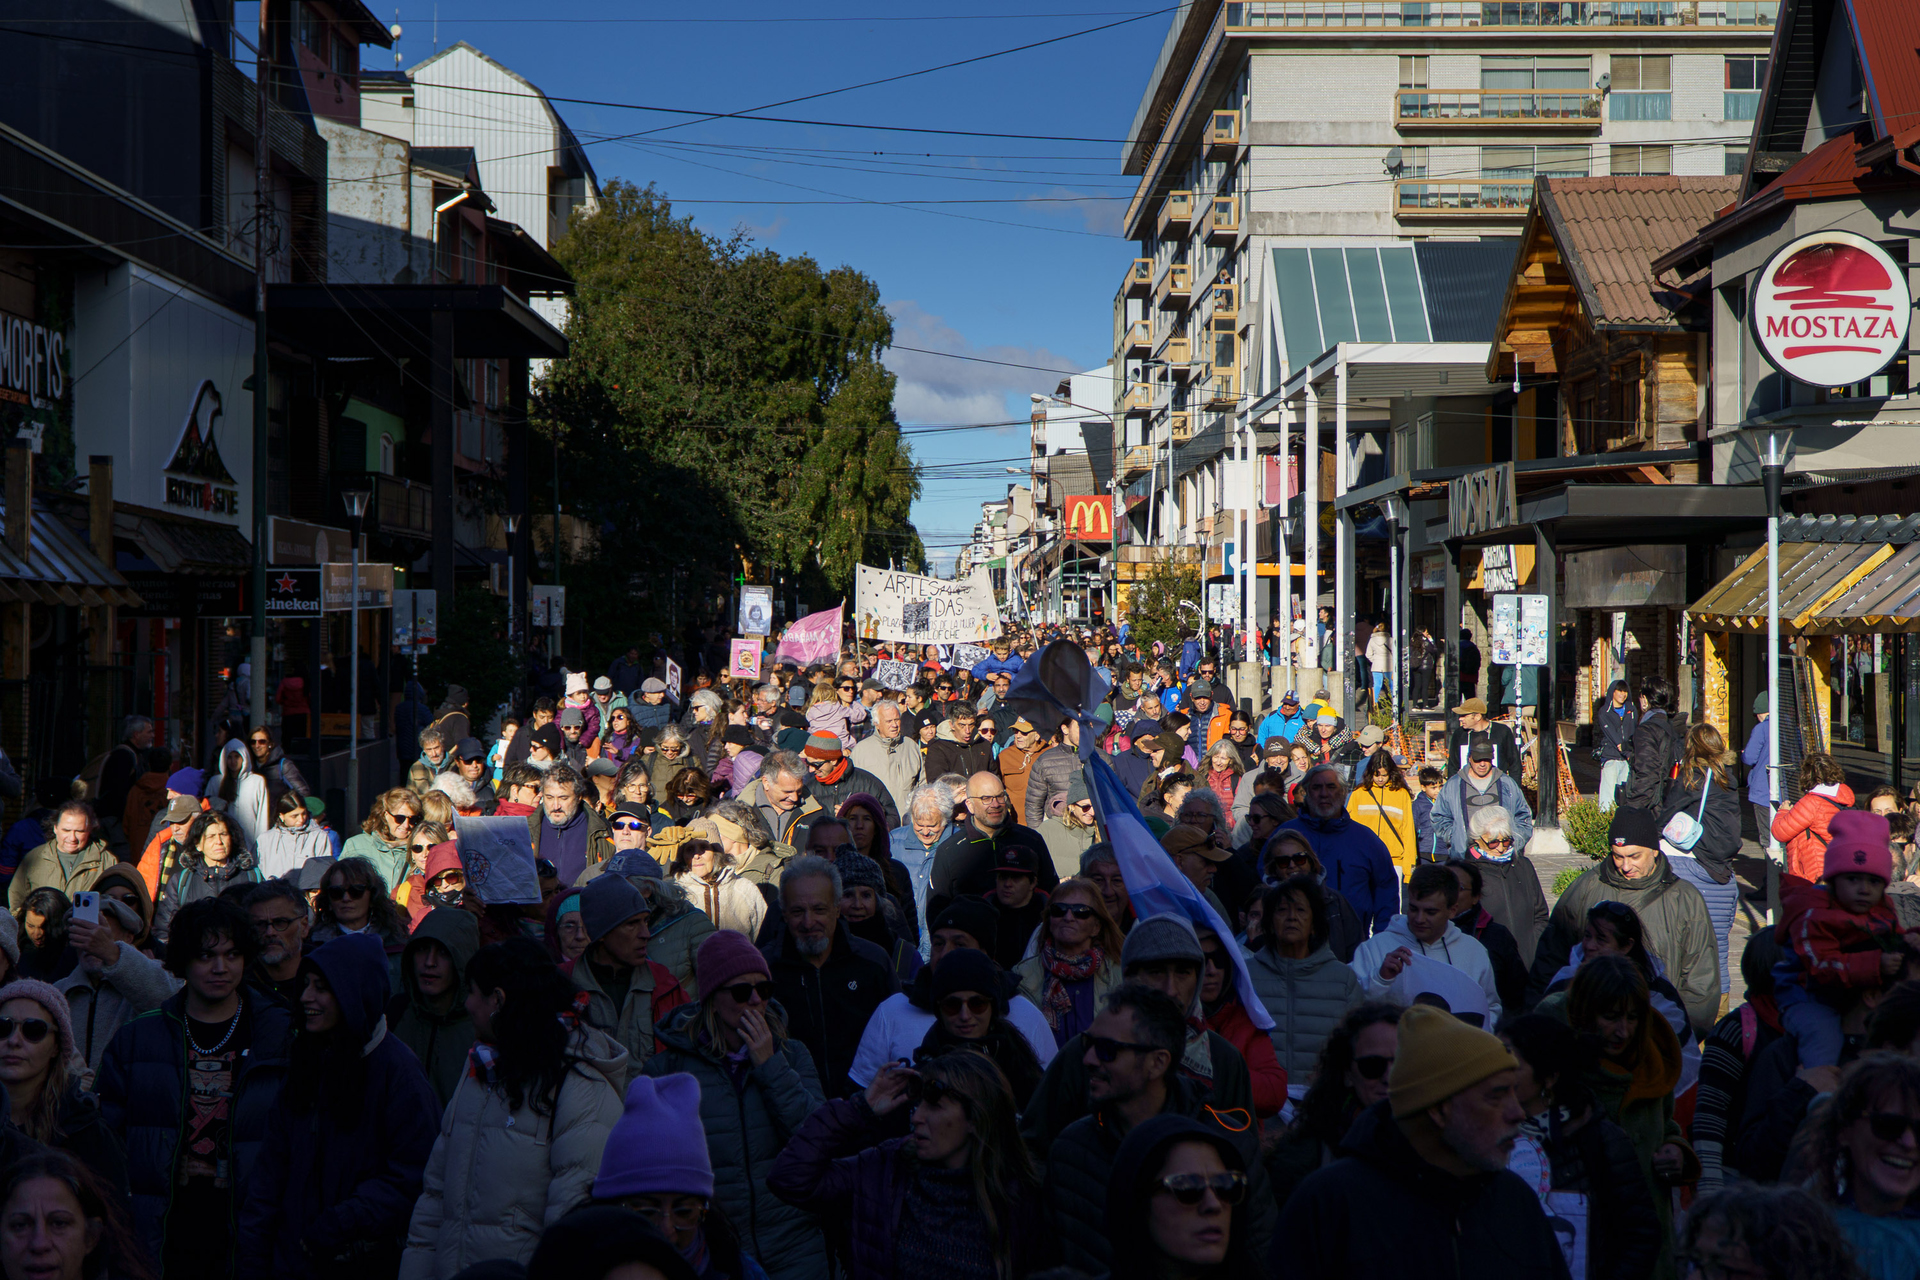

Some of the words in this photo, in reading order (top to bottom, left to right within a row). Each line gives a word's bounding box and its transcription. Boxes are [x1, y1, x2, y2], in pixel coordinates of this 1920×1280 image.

[1765, 314, 1899, 340] MOSTAZA
[1448, 461, 1518, 538] MOSTAZA
[264, 596, 319, 611] eineken
